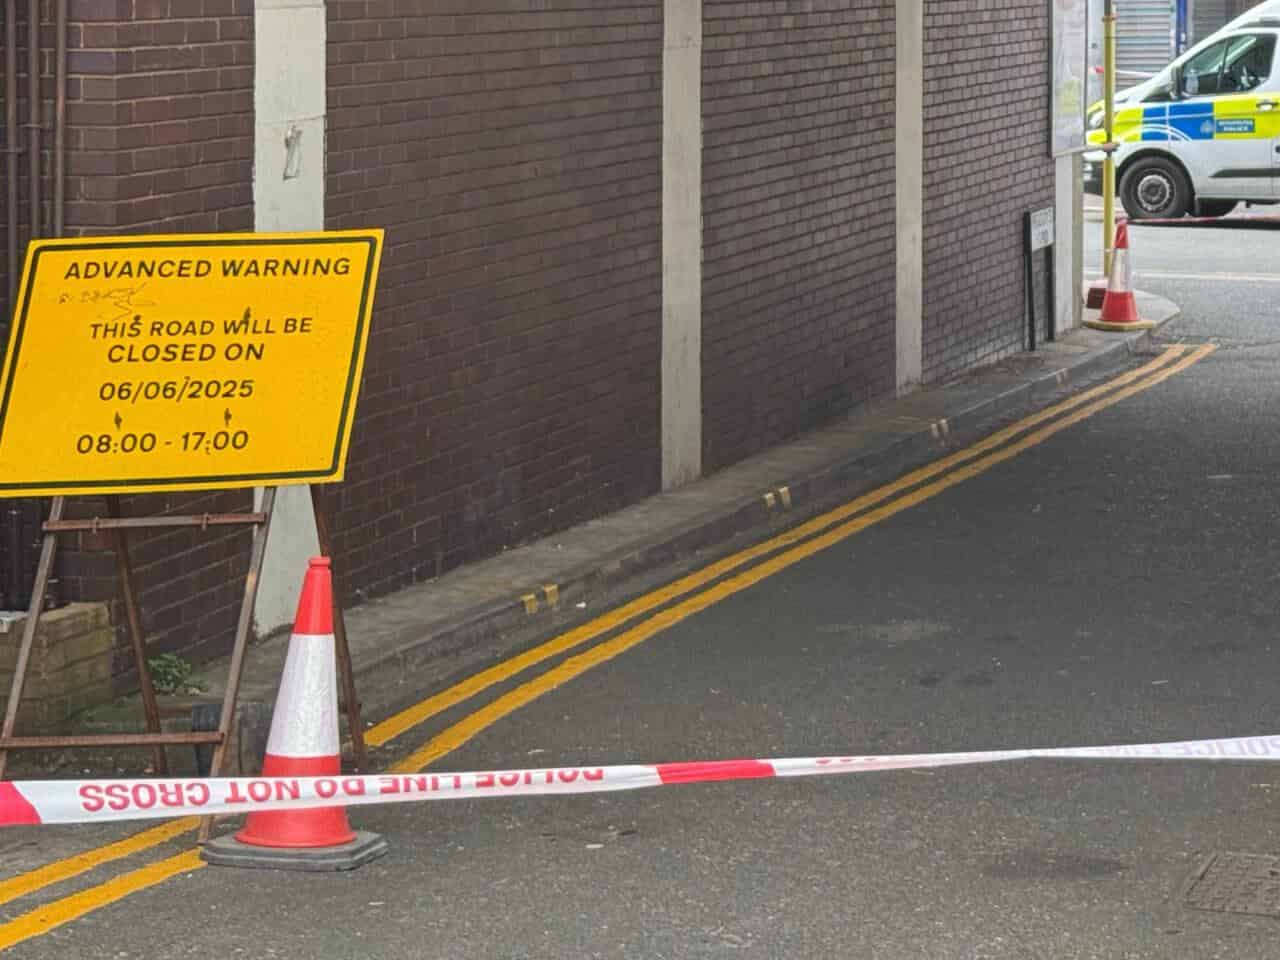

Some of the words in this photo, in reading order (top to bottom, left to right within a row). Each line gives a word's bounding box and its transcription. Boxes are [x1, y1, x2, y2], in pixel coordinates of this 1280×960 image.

[64, 260, 211, 279] ADVANCED
[221, 257, 351, 277] WARNING
[90, 321, 141, 339] THIS
[149, 320, 215, 337] ROAD
[223, 318, 276, 335] WILL
[284, 317, 313, 333] BE
[107, 344, 215, 363] CLOSED
[224, 343, 264, 361] ON
[99, 379, 254, 403] 06/06/2025
[76, 433, 156, 454] 08:00
[181, 431, 249, 453] 17:00
[79, 782, 210, 812] CROSS
[225, 780, 300, 804] NOT
[314, 778, 366, 799] DO
